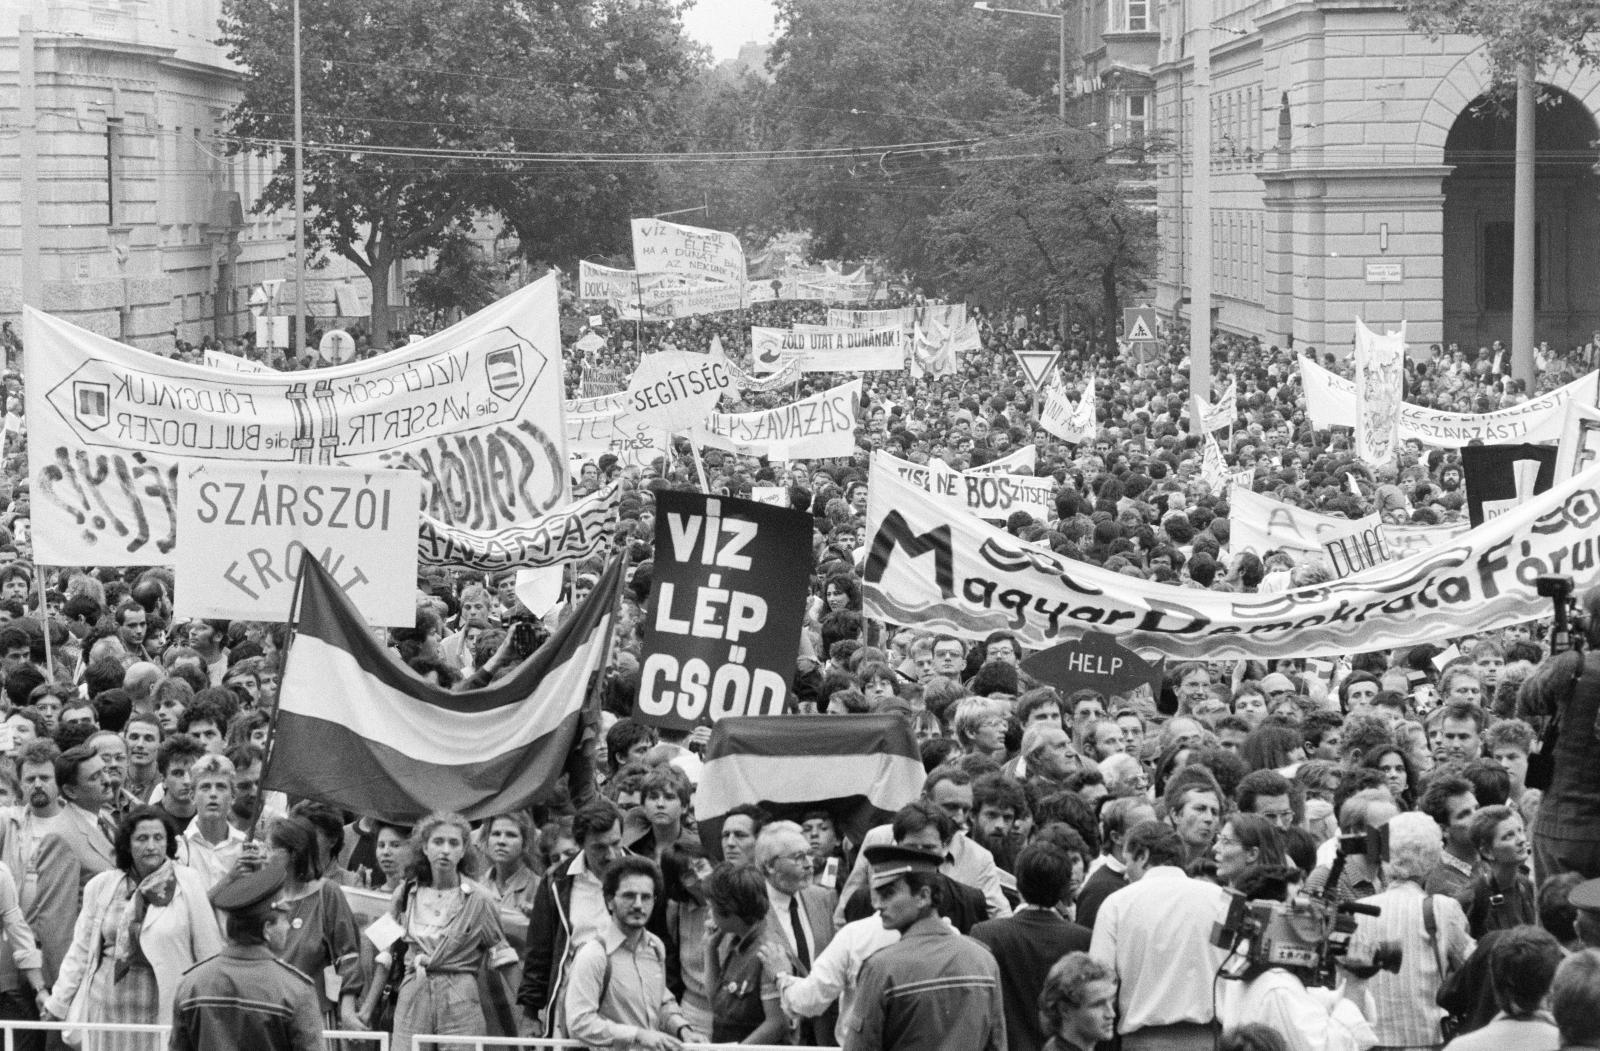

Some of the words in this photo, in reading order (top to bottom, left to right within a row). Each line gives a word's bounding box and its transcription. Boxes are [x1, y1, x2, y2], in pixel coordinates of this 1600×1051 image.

[781, 331, 804, 350] ZÖLD
[810, 333, 833, 350] UTAT
[836, 334, 844, 349] A
[634, 362, 730, 412] SEGÍTSÉG
[197, 469, 391, 531] SZÁRSZÓI
[936, 472, 959, 496] NE
[419, 514, 587, 562] ANAMA
[667, 498, 758, 571] VÍZ
[864, 509, 1135, 639] Magyar
[1135, 575, 1471, 636] Demokrata
[1477, 535, 1600, 600] Fóru
[655, 573, 768, 642] LÉP
[1068, 651, 1123, 676] HELP
